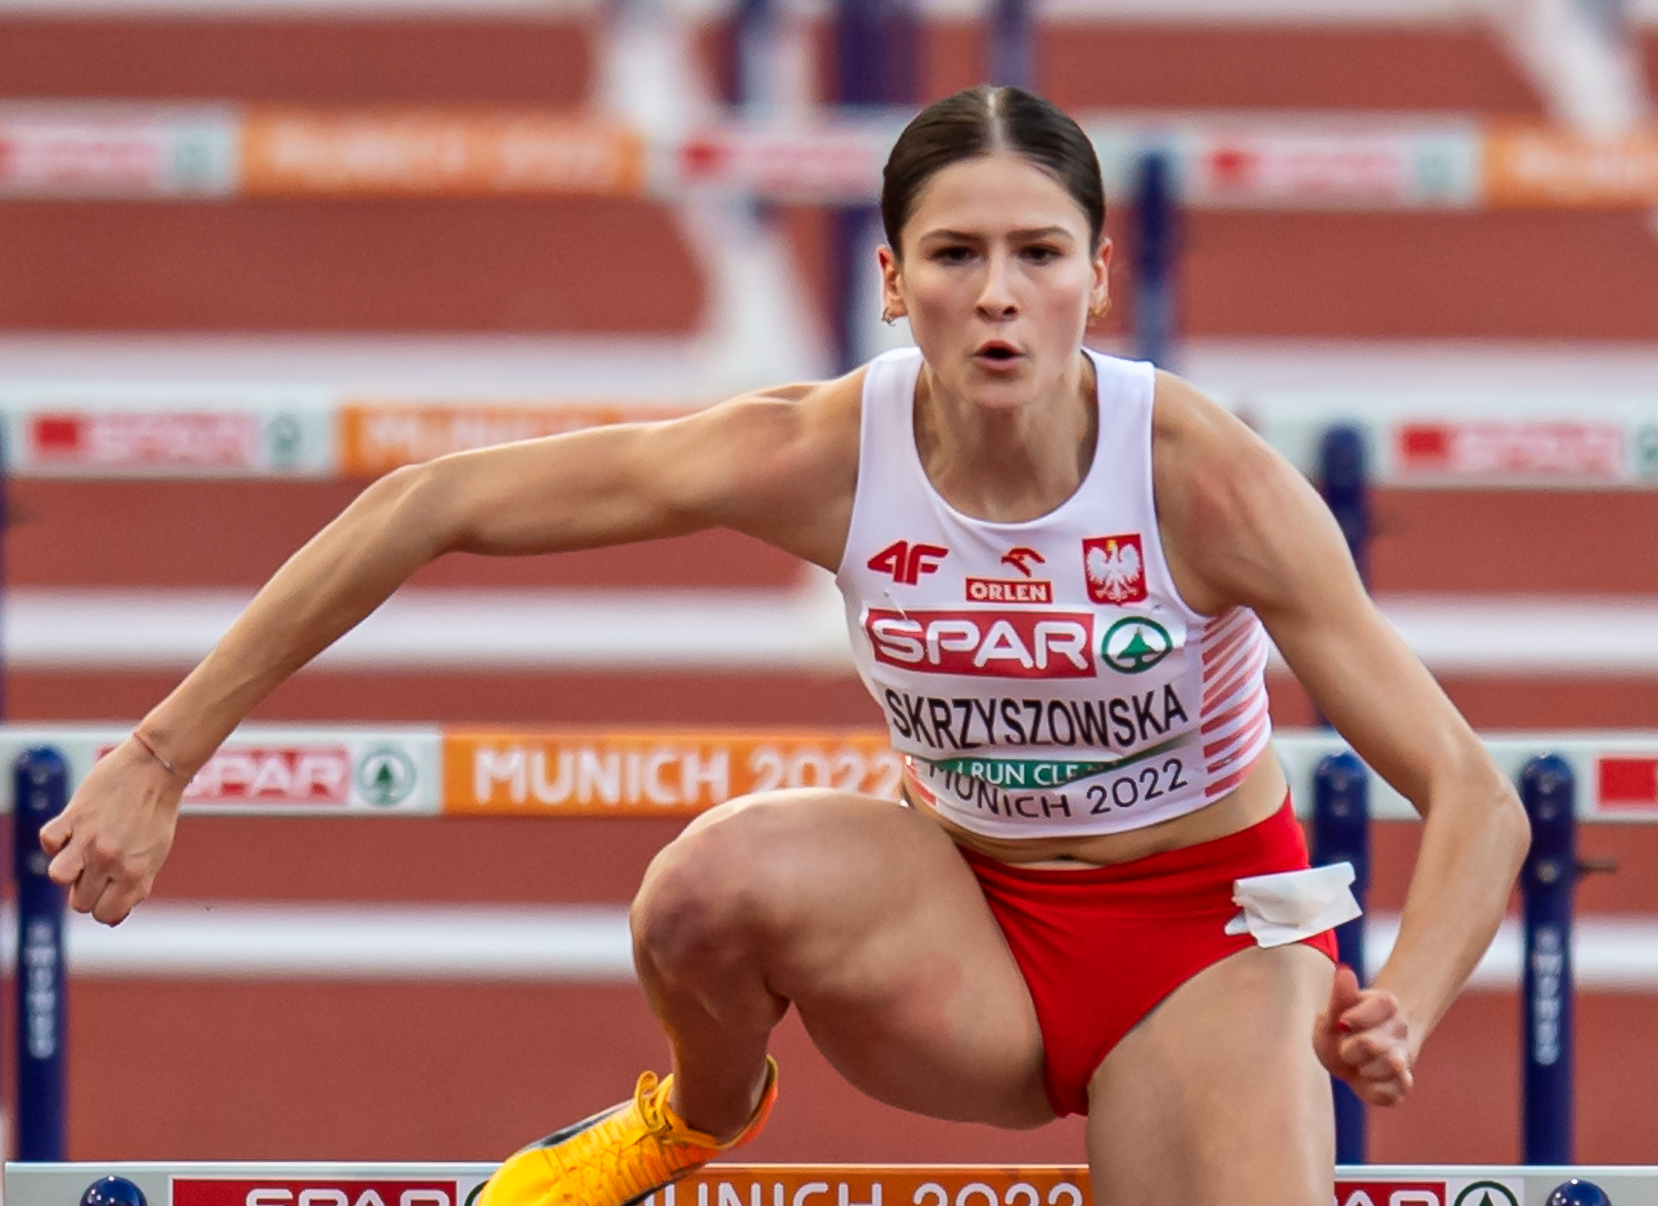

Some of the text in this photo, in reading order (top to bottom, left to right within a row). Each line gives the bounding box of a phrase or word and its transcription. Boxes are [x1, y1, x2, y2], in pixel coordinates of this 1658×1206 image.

[866, 539, 949, 586] 4F
[970, 581, 1047, 602] ORLEN
[871, 619, 1089, 670] SPAR
[885, 684, 1189, 750] SKRZYSZOWSKA
[474, 747, 902, 805] MUNICH 2022
[970, 761, 1025, 785] RUN
[1086, 758, 1188, 815] 2022
